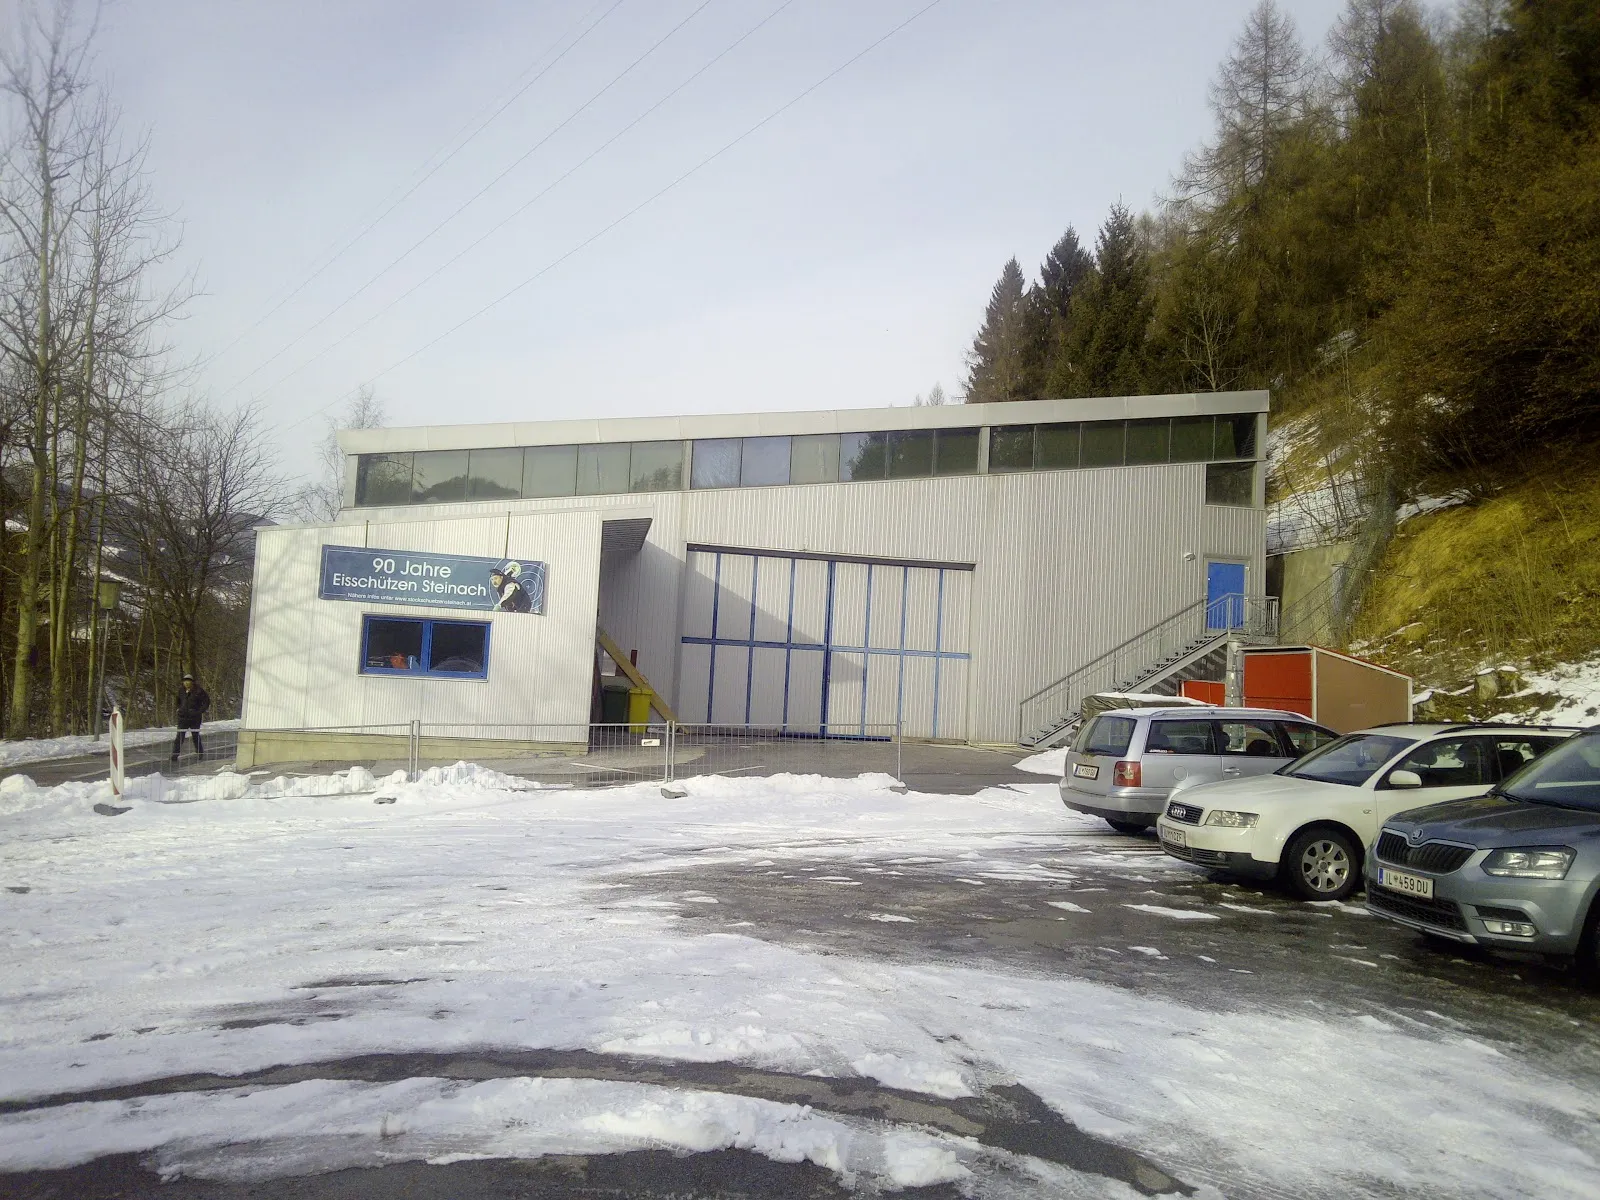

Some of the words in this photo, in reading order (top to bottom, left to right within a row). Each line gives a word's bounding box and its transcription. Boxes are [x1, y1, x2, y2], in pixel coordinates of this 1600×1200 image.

[372, 557, 396, 574] 90
[400, 560, 452, 578] Jahre
[332, 572, 418, 592] Eisschützen
[421, 579, 487, 597] Steinach
